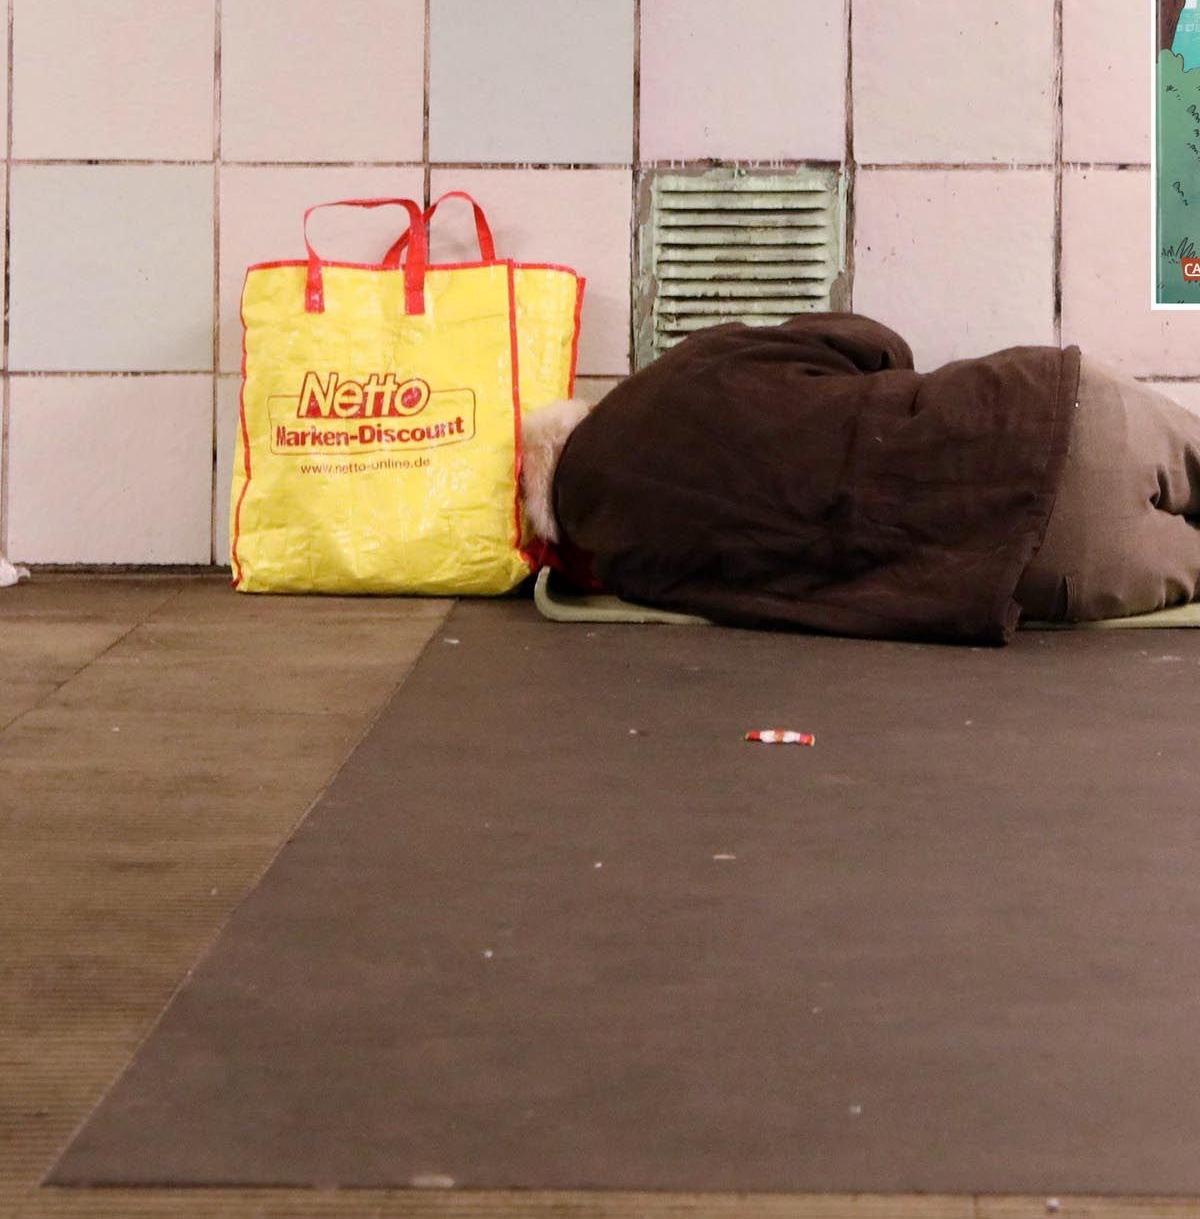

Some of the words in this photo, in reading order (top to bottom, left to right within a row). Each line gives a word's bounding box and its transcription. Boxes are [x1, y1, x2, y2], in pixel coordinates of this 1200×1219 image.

[297, 371, 431, 419] Netto
[276, 416, 464, 448] Marken-Discount
[300, 457, 431, 475] www.netto-online.de
